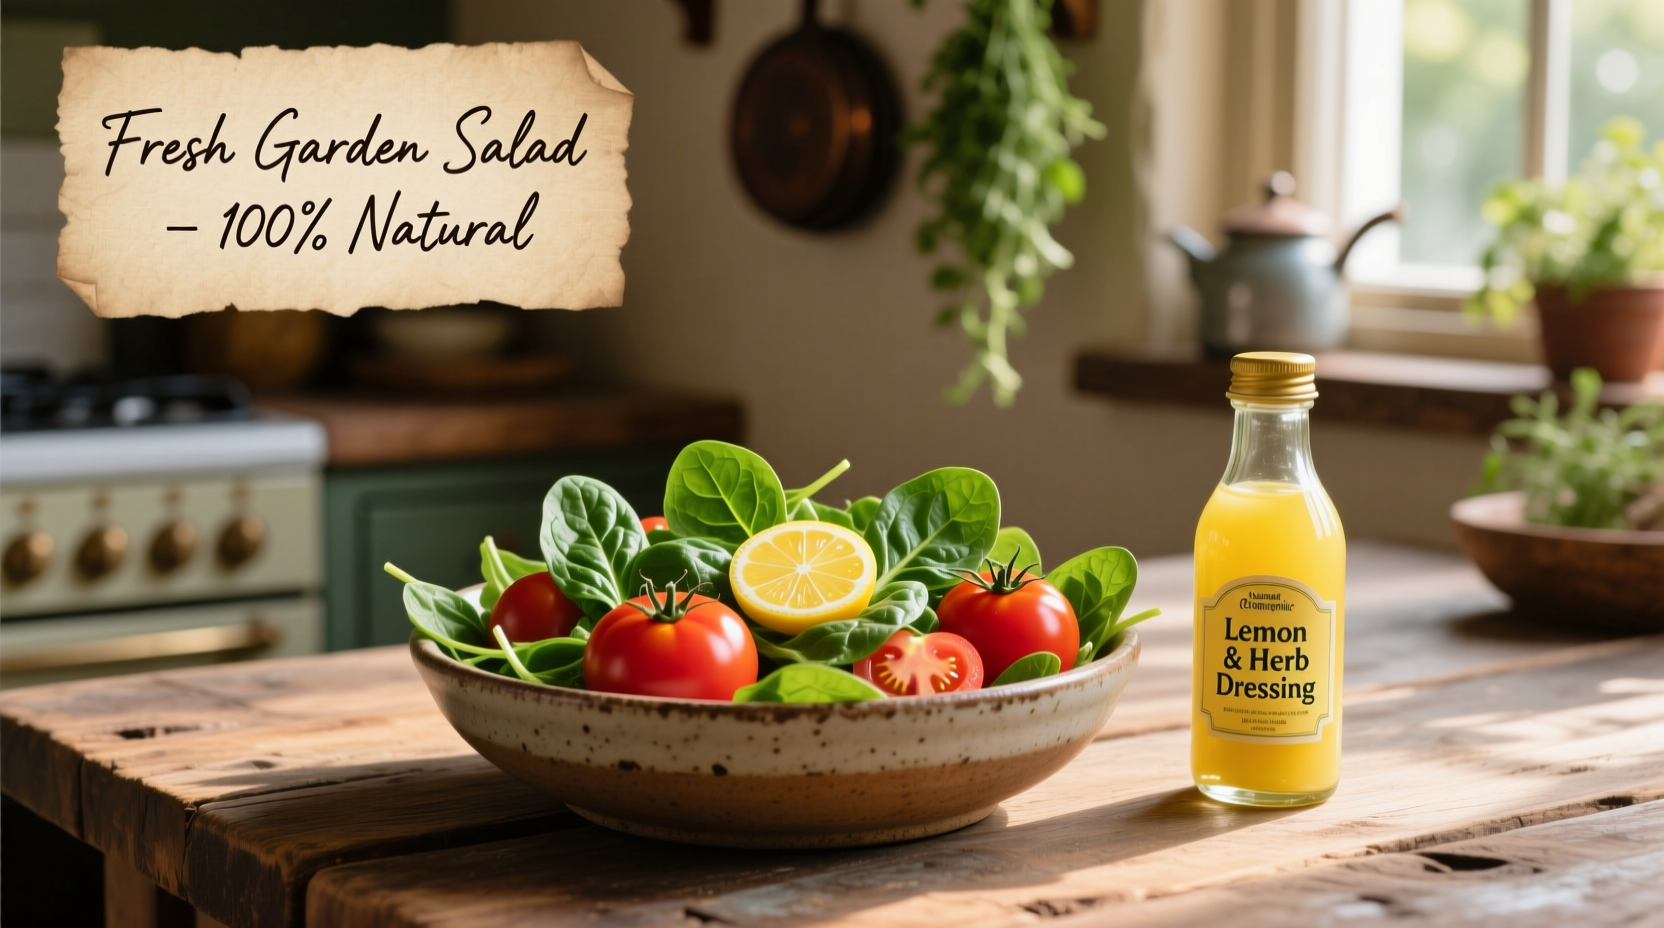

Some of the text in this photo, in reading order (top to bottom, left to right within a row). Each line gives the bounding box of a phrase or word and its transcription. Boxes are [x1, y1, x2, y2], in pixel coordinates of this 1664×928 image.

[1224, 617, 1307, 643] Lemon
[1223, 645, 1310, 672] & Herb
[1215, 671, 1316, 706] Dressing
